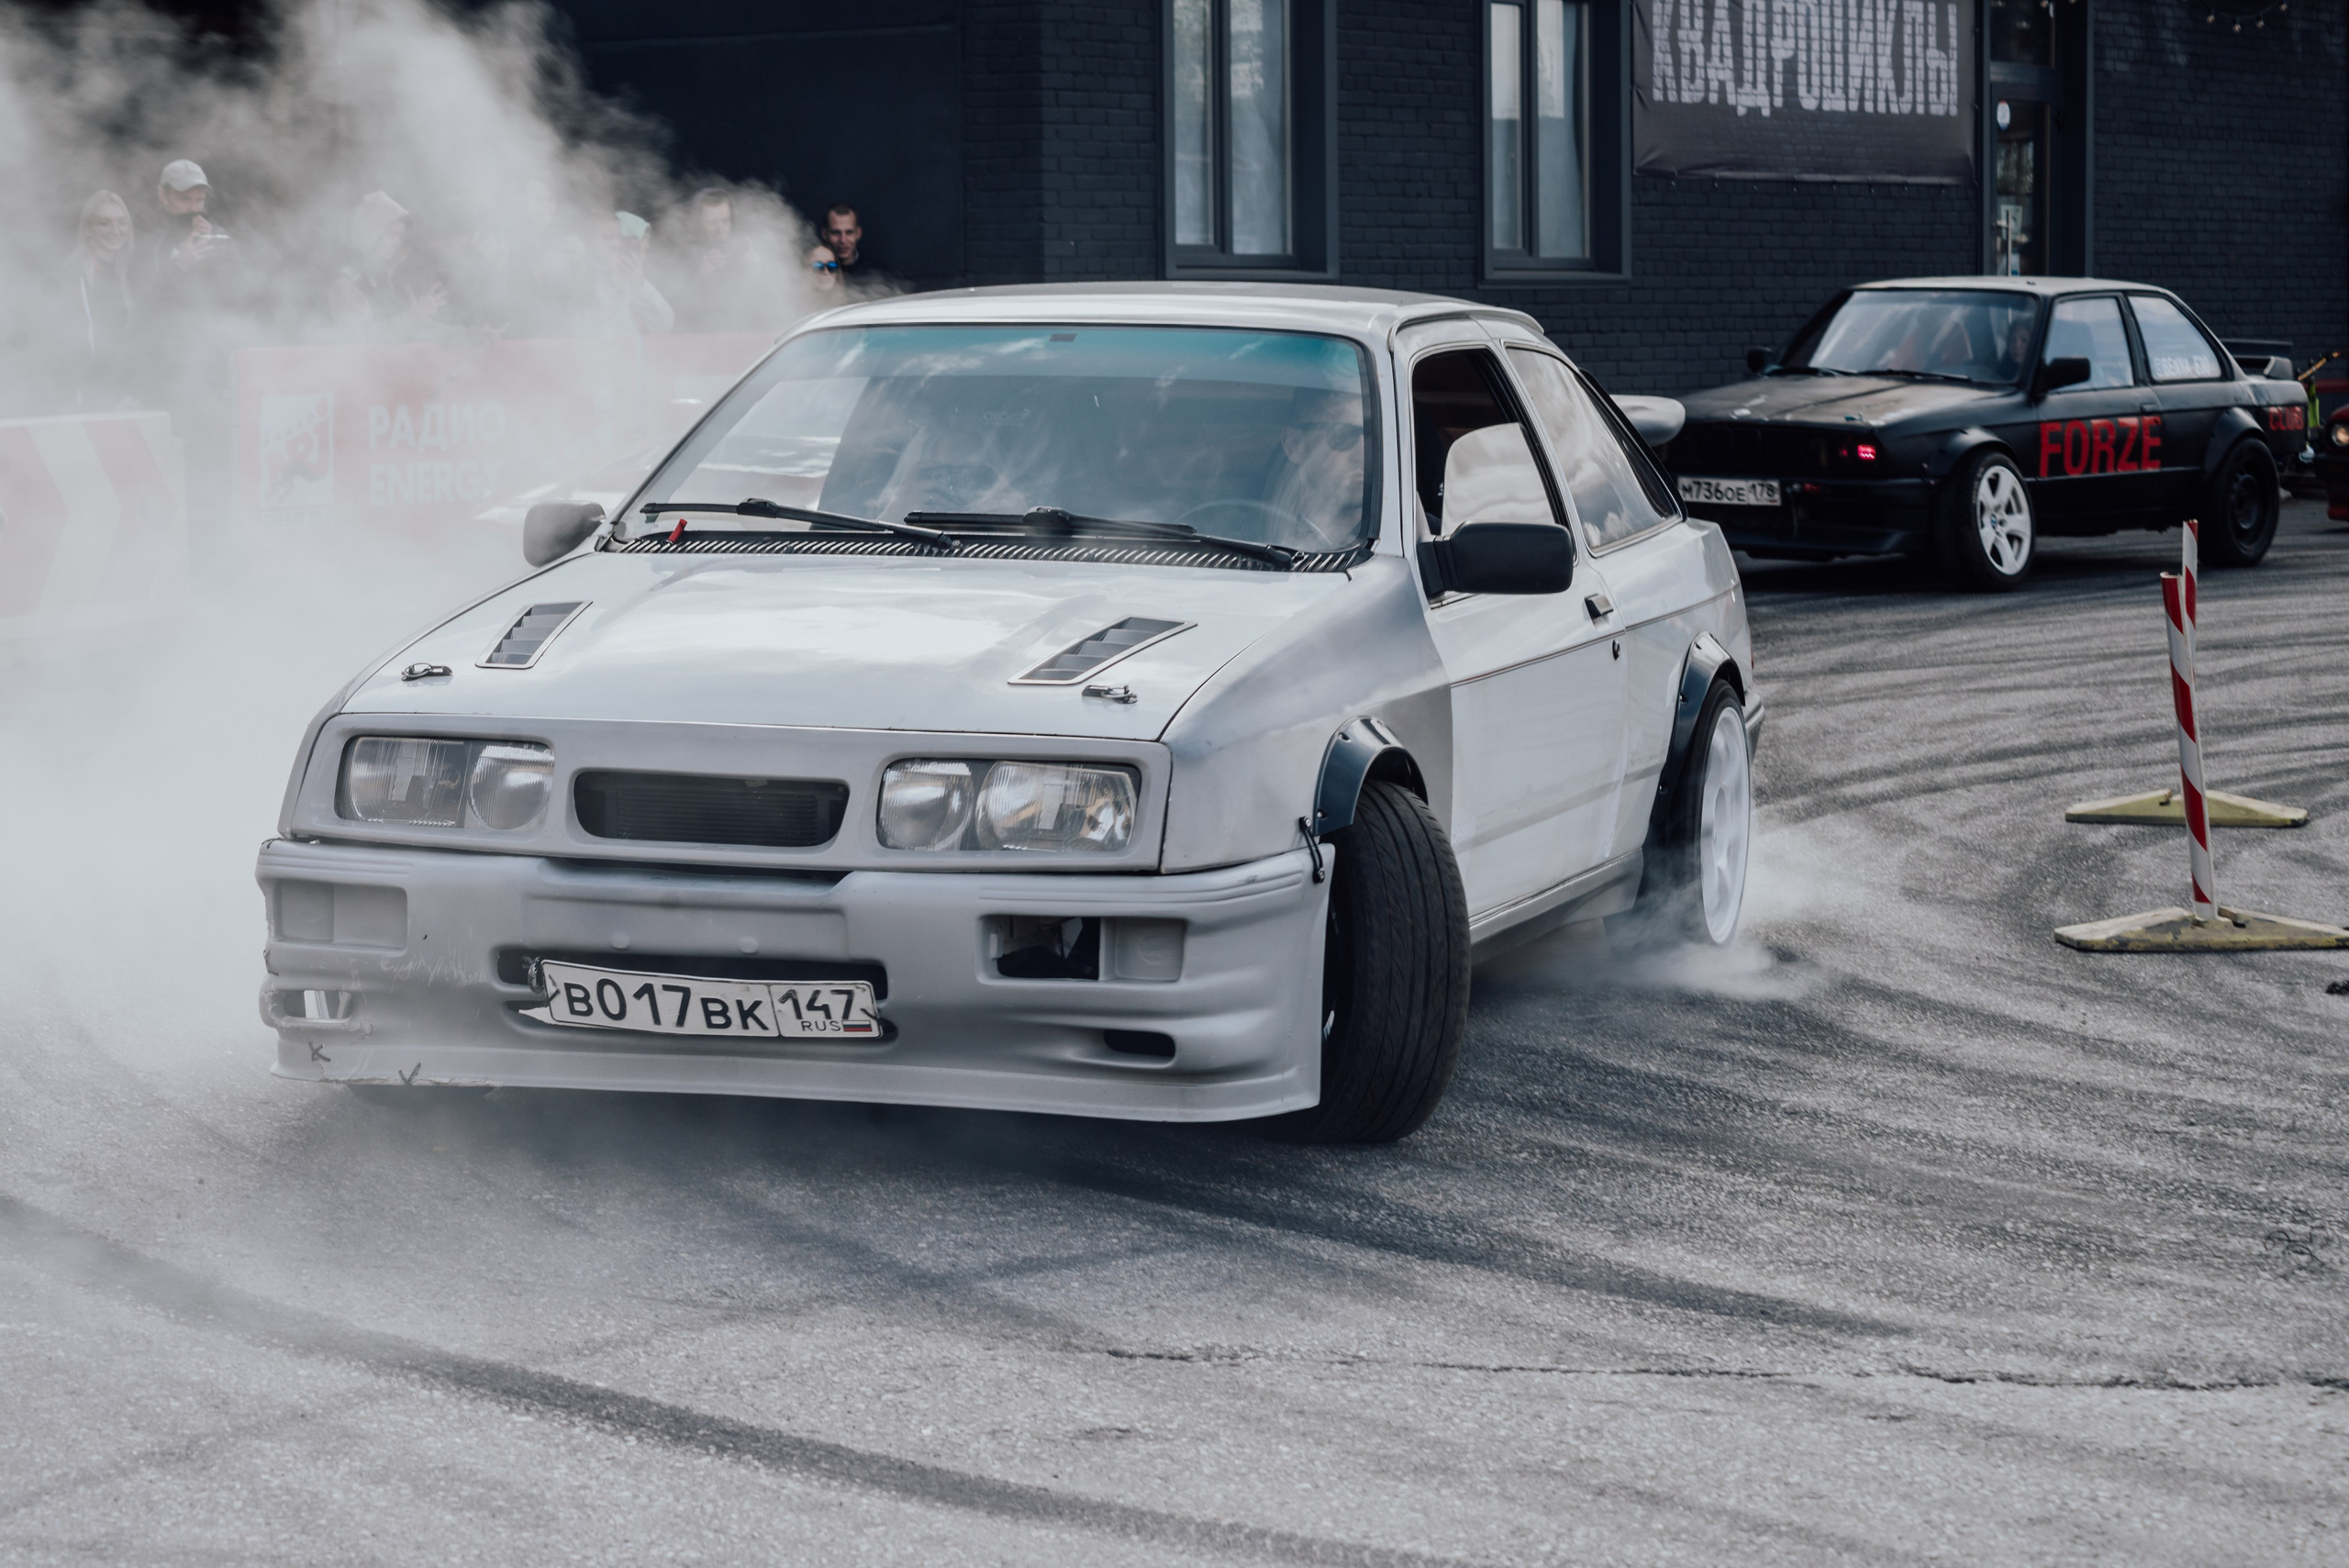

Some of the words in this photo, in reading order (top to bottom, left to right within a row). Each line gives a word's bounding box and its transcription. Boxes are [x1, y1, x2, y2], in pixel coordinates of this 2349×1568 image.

[369, 400, 507, 453] РАДИО
[2039, 415, 2162, 478] FORZE
[2268, 406, 2304, 431] CLUB
[369, 459, 505, 507] ENERGY
[777, 988, 855, 1020] 147
[801, 1019, 841, 1033] RUS
